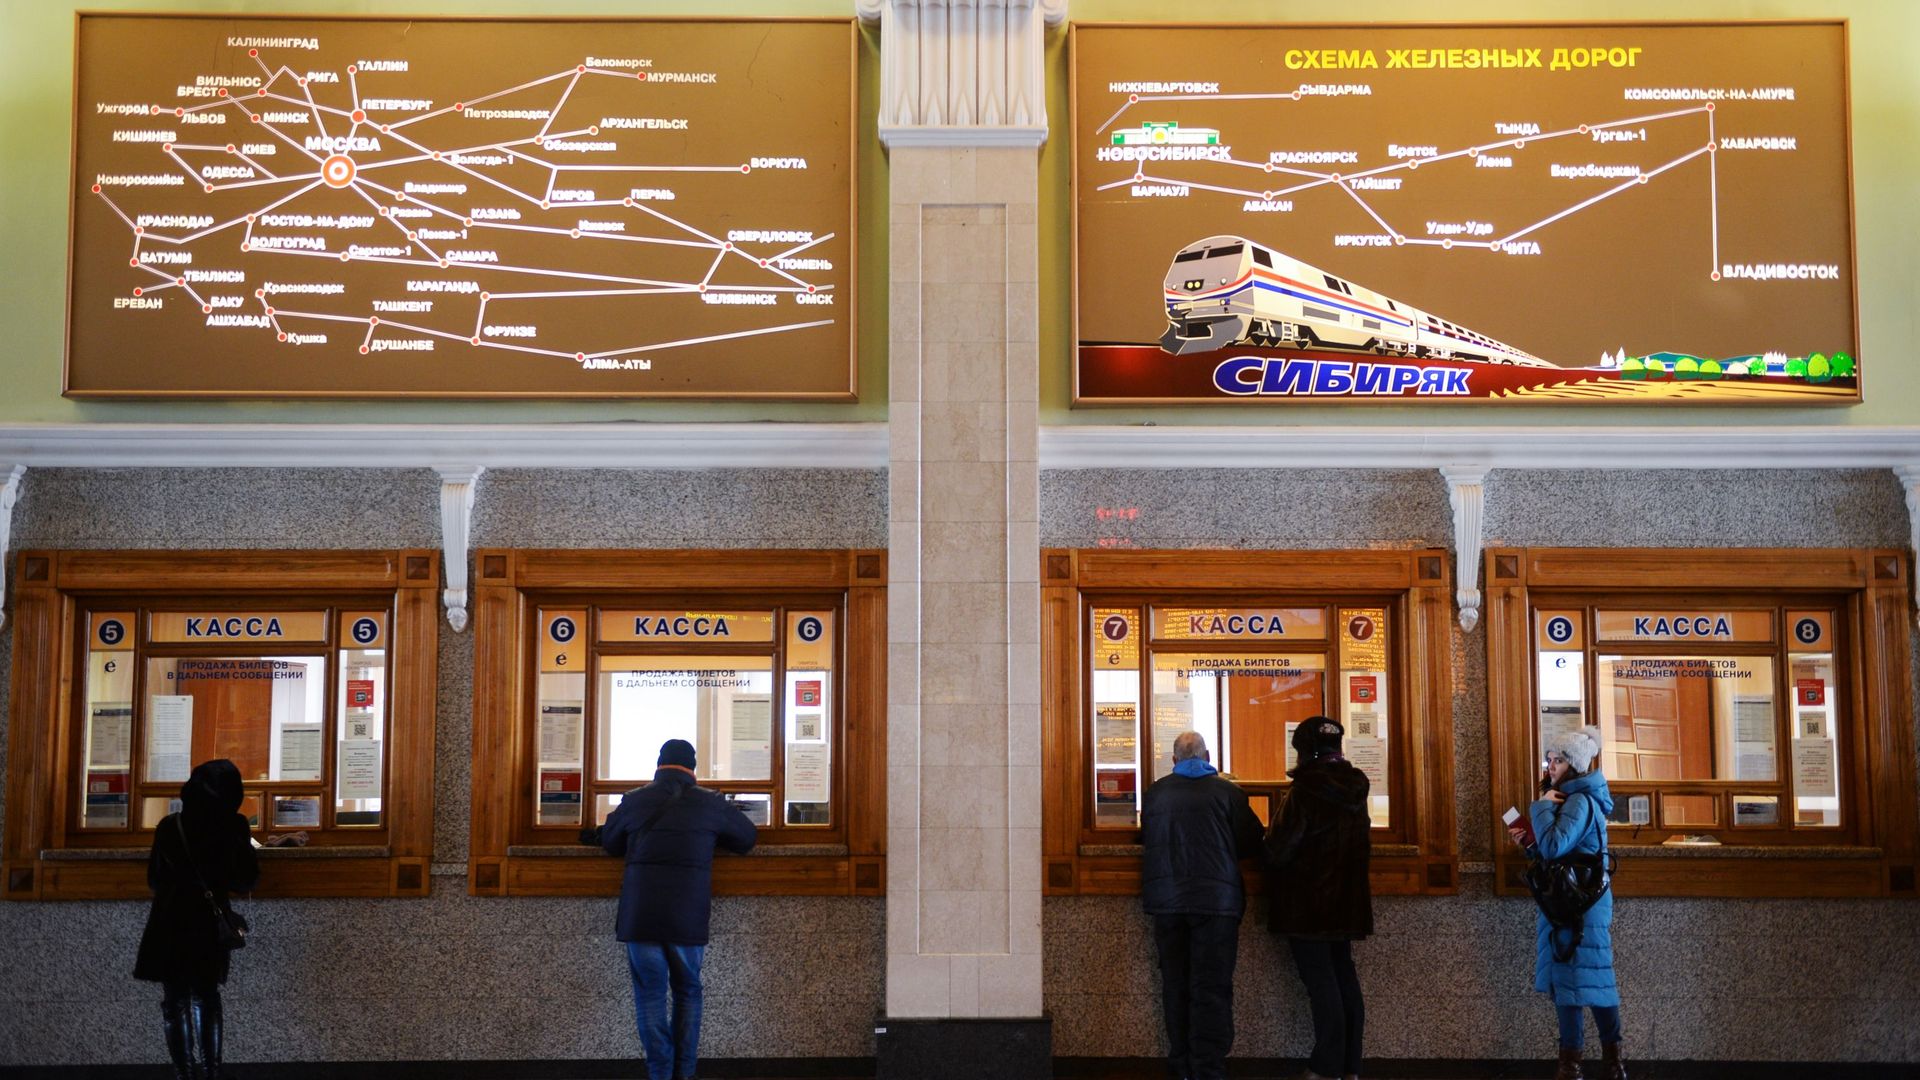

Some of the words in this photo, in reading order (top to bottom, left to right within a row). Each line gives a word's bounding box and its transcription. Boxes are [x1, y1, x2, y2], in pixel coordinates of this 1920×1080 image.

[228, 37, 319, 49] КАЛИНИНГРАД
[358, 60, 408, 71] ТАЛЛИН
[586, 57, 652, 69] Беломорск
[1284, 50, 1378, 69] СХЕМА
[1386, 48, 1542, 68] ЖЕЛЕЗНЫХ
[1550, 48, 1642, 71] ДОРОГ
[196, 76, 261, 87] ВИЛЬНЮС
[307, 72, 339, 83] РИГА
[647, 73, 716, 84] МУРМАНСК
[177, 87, 218, 97] БРЕСТ
[1109, 82, 1219, 93] НИЖНЕВАРТОВСК
[1300, 84, 1371, 96] СЫВДАРМА
[1624, 88, 1794, 100] КОМСОМОЛЬСК-НА-АМУРЕ
[97, 104, 149, 116] Ужгород
[362, 99, 433, 110] ПЕТЕРБУРГ
[181, 114, 226, 124] ЛЬВОВ
[263, 112, 309, 123] МИНСК
[465, 109, 550, 120] Петрозаводск
[600, 118, 688, 130] АРХАНГЕЛЬСК
[1495, 123, 1540, 135] ТЫНДА
[113, 131, 177, 142] КИШИНЕВ
[1592, 129, 1646, 142] Ургал-1
[242, 144, 276, 155] КИЕВ
[305, 136, 381, 151] МОСКВА
[1720, 138, 1796, 150] ХАБАРОВСК
[1098, 146, 1232, 161] НОВОСИБИРСК
[1388, 145, 1437, 157] Братск
[451, 155, 514, 165] Вологда-1
[751, 158, 807, 169] ВОРКУТА
[1270, 152, 1357, 163] КРАСНОЯРСК
[1475, 155, 1512, 167] Лена
[202, 167, 254, 179] ОДЕССА
[1550, 164, 1640, 178] Биробиджан
[97, 174, 184, 188] Новороссийск
[1350, 178, 1402, 190] ТАЙШЕТ
[405, 183, 467, 194] Владимир
[631, 189, 675, 200] ПЕРМЬ
[1132, 186, 1189, 197] БАРНАУЛ
[551, 191, 595, 201] КИРОВ
[1243, 201, 1292, 212] АБАКАН
[471, 208, 521, 220] КАЗАНЬ
[137, 215, 214, 228] КРАСНОДАР
[261, 215, 375, 228] РОСТОВ-НА-ДОНУ
[1426, 221, 1493, 235] Улан-Удэ
[727, 230, 813, 243] СВЕРДЛОВСК
[1335, 236, 1392, 247] ИРКУТСК
[250, 237, 325, 250] ВОЛГОГРАД
[1502, 242, 1541, 255] ЧИТА
[140, 252, 192, 264] БАТУМИ
[445, 251, 498, 262] САМАРА
[777, 258, 833, 270] ТЮМЕНЬ
[184, 271, 245, 282] ТБИЛИСИ
[1723, 264, 1838, 280] ВЛАДИВОСТОК
[264, 282, 344, 294] Красноводск
[407, 281, 479, 293] КАРАГАНДА
[114, 298, 162, 309] ЕРЕВАН
[211, 296, 244, 308] БАКУ
[701, 293, 777, 305] ЧЕЛЯБИНСК
[796, 294, 833, 304] ОМСК
[373, 301, 433, 312] ТАШКЕНТ
[206, 316, 270, 327] АШХАБАД
[484, 326, 536, 337] ФРУНЗЕ
[287, 332, 327, 344] Кушка
[371, 340, 434, 351] ДУШАНБЕ
[583, 359, 651, 370] АЛМА-АТЫ
[1213, 356, 1474, 395] СИБИРЯК
[185, 617, 283, 637] КАССА
[557, 623, 569, 637] 6
[634, 616, 730, 636] КАССА
[804, 622, 816, 637] 6
[1109, 621, 1123, 637] 7
[1190, 615, 1284, 635] КАССА
[1354, 621, 1369, 636] 7
[1553, 621, 1566, 637] 8
[1634, 617, 1731, 636] КАССА
[1801, 623, 1814, 639] 8
[105, 625, 118, 640] 5
[359, 624, 371, 639] 5
[182, 660, 236, 670] ПРОДАЖА
[239, 660, 289, 670] БИЛЕТОВ
[1192, 659, 1241, 668] ПРОДАЖА
[1244, 658, 1290, 667] БИЛЕТОВ
[1631, 660, 1684, 669] ПРОДАЖА
[1687, 659, 1736, 669] БИЛЕТОВ
[167, 671, 174, 679] В
[176, 671, 230, 681] ДАЛЬНЕМ
[232, 671, 303, 681] СООБЩЕНИИ
[632, 669, 684, 679] ПРОДАЖА
[687, 669, 736, 678] БИЛЕТОВ
[1178, 669, 1184, 678] В
[1187, 669, 1235, 678] ДАЛЬНЕМ
[1238, 669, 1301, 678] СООБЩЕНИИ
[1616, 670, 1623, 678] В
[1626, 669, 1679, 679] ДАЛЬНЕМ
[1681, 669, 1752, 679] СООБЩЕНИИ
[617, 679, 623, 687] В
[626, 679, 678, 689] ДАЛЬНЕМ
[681, 679, 750, 688] СООБЩЕНИИ
